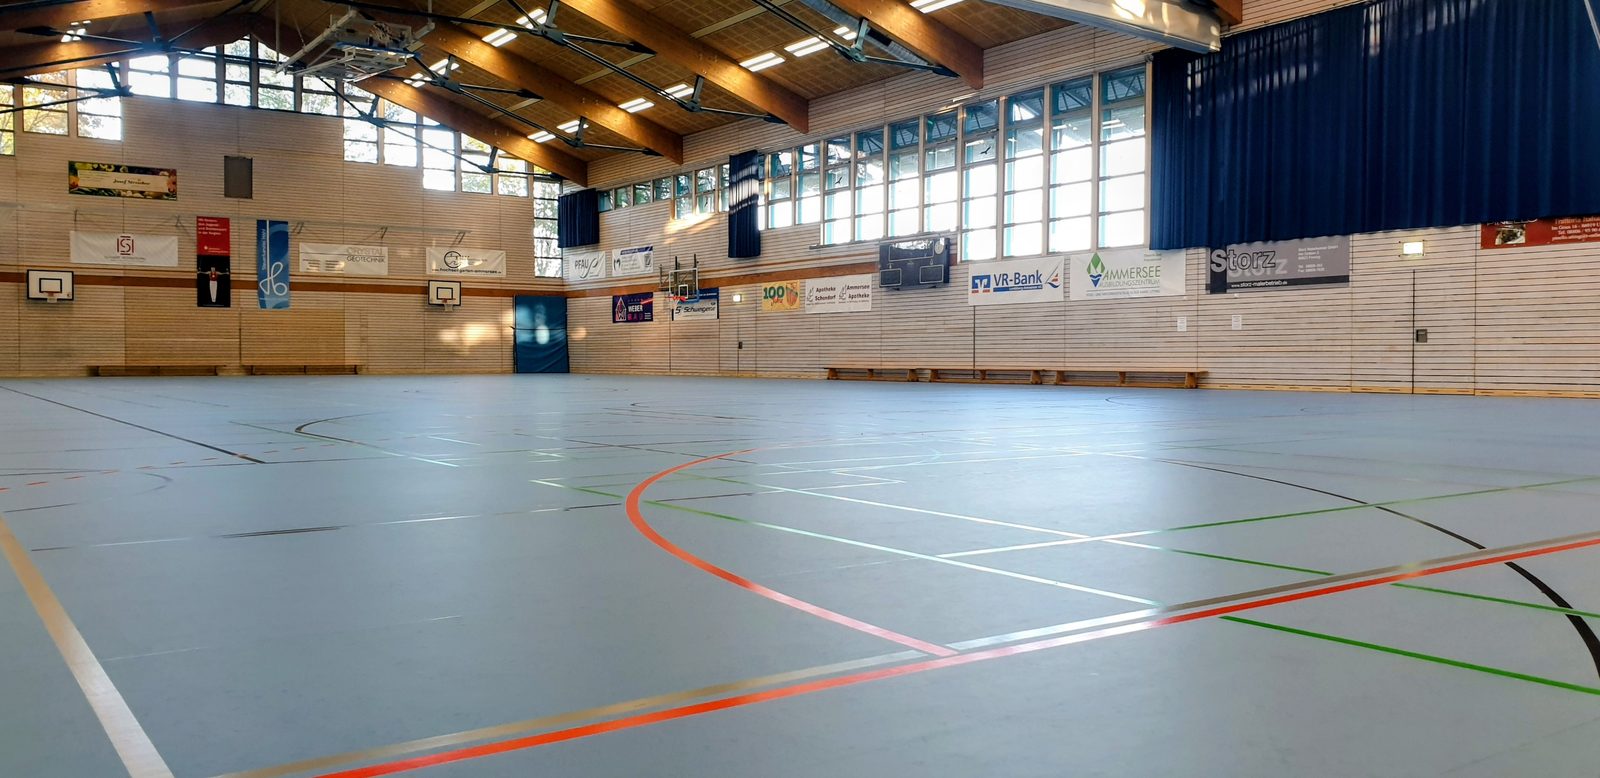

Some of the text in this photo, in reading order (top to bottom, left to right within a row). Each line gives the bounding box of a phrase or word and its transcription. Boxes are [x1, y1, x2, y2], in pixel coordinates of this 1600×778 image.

[1210, 248, 1276, 272] Storz
[994, 270, 1042, 286] VR-Bank
[1103, 266, 1160, 280] AMMERSEE
[764, 286, 784, 300] 100
[628, 304, 643, 312] WEBER
